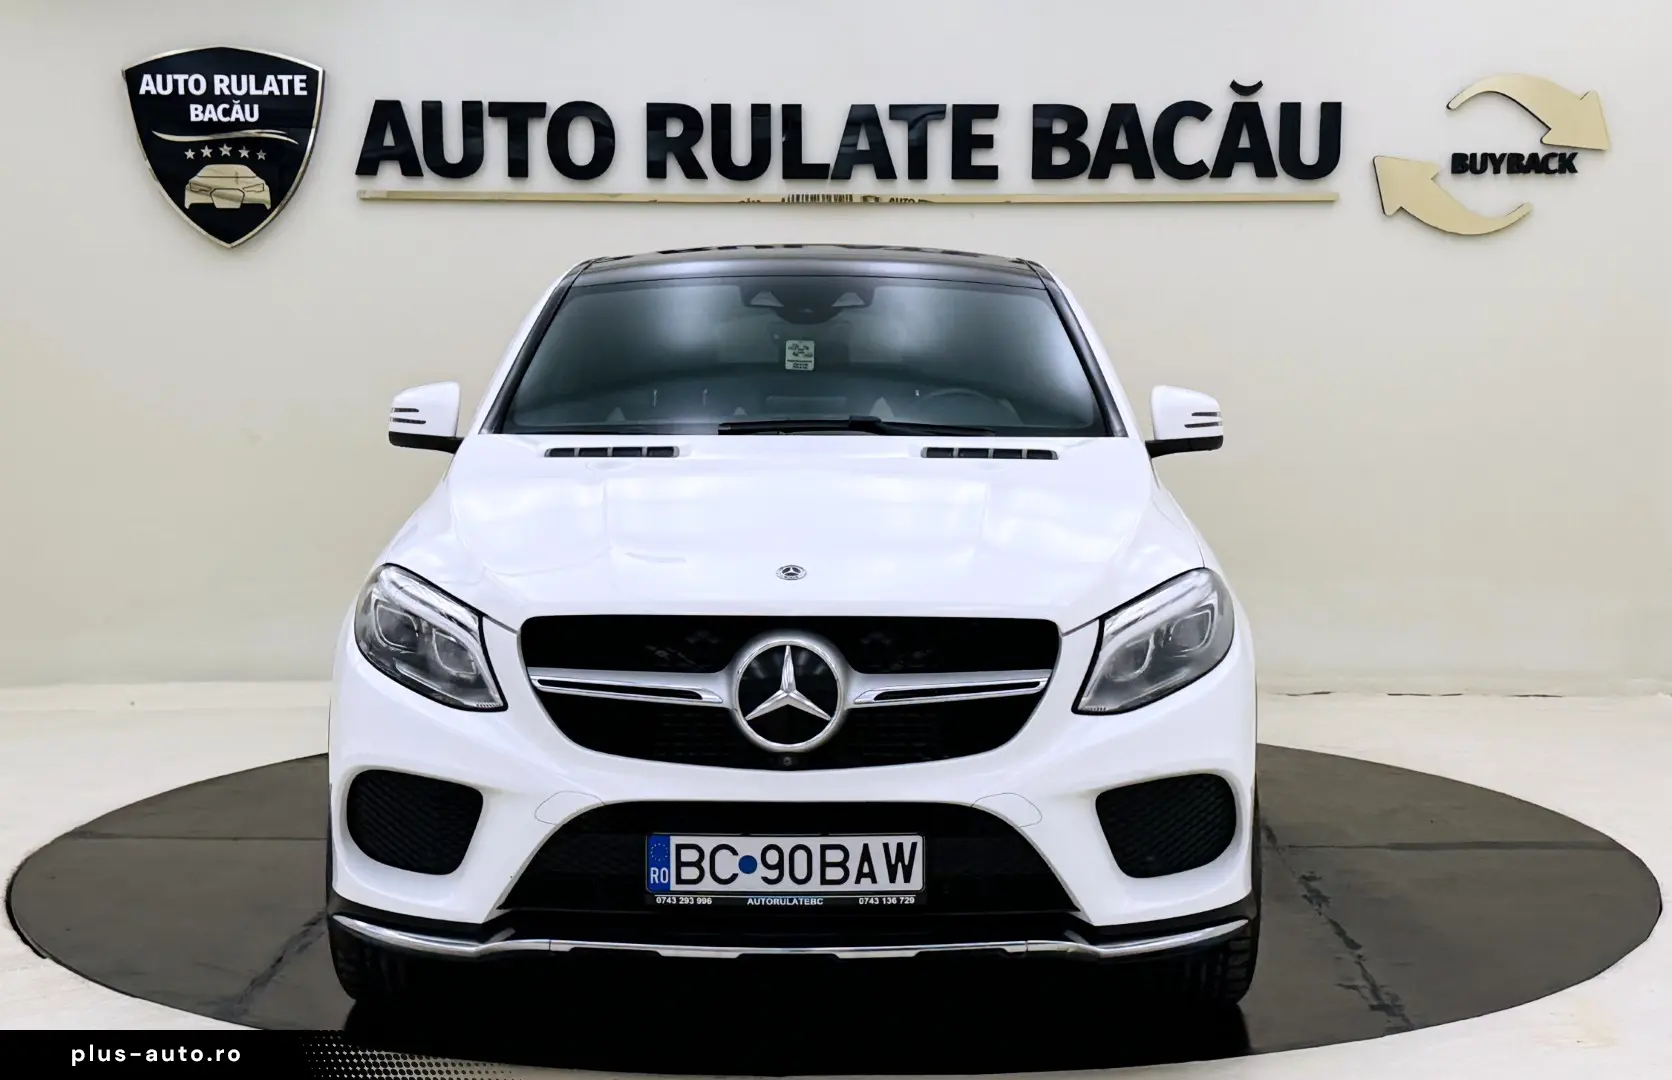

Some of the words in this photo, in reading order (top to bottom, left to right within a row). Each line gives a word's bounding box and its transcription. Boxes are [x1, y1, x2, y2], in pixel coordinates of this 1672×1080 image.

[139, 73, 207, 96] AUTO
[213, 74, 308, 96] RULATE
[189, 99, 260, 123] BACĂU
[355, 99, 616, 181] AUTO
[646, 102, 1000, 181] RULATE
[1031, 80, 1342, 181] BACĂU
[1451, 152, 1579, 175] BUYBACK
[650, 867, 669, 884] RO
[656, 896, 677, 904] 0743
[679, 896, 694, 905] 293
[747, 897, 824, 906] AUTORULATEBC
[858, 897, 879, 905] 0743
[882, 897, 897, 905] 136
[899, 896, 915, 904] 729
